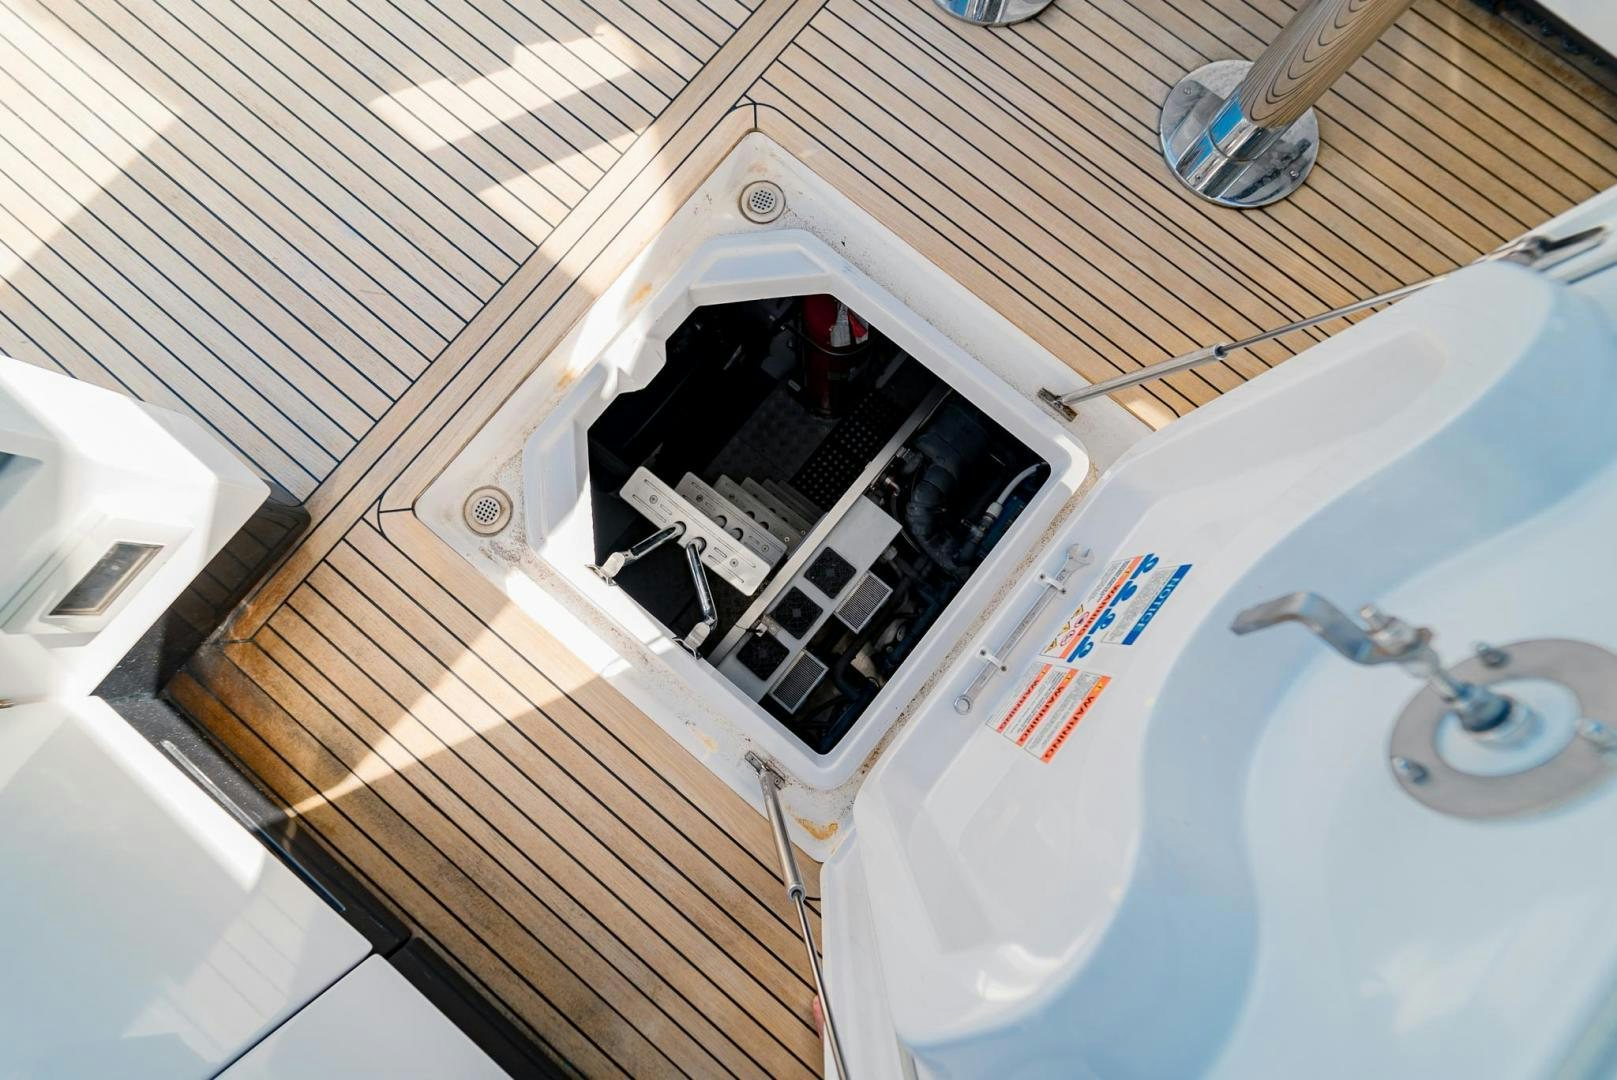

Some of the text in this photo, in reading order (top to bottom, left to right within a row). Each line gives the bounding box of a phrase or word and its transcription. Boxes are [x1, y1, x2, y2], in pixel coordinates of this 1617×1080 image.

[1077, 583, 1121, 637] WARNING
[1138, 576, 1180, 628] NOTICE
[998, 680, 1039, 731] WARNING
[1019, 684, 1064, 744] WARNING
[1044, 695, 1096, 759] WARNING
